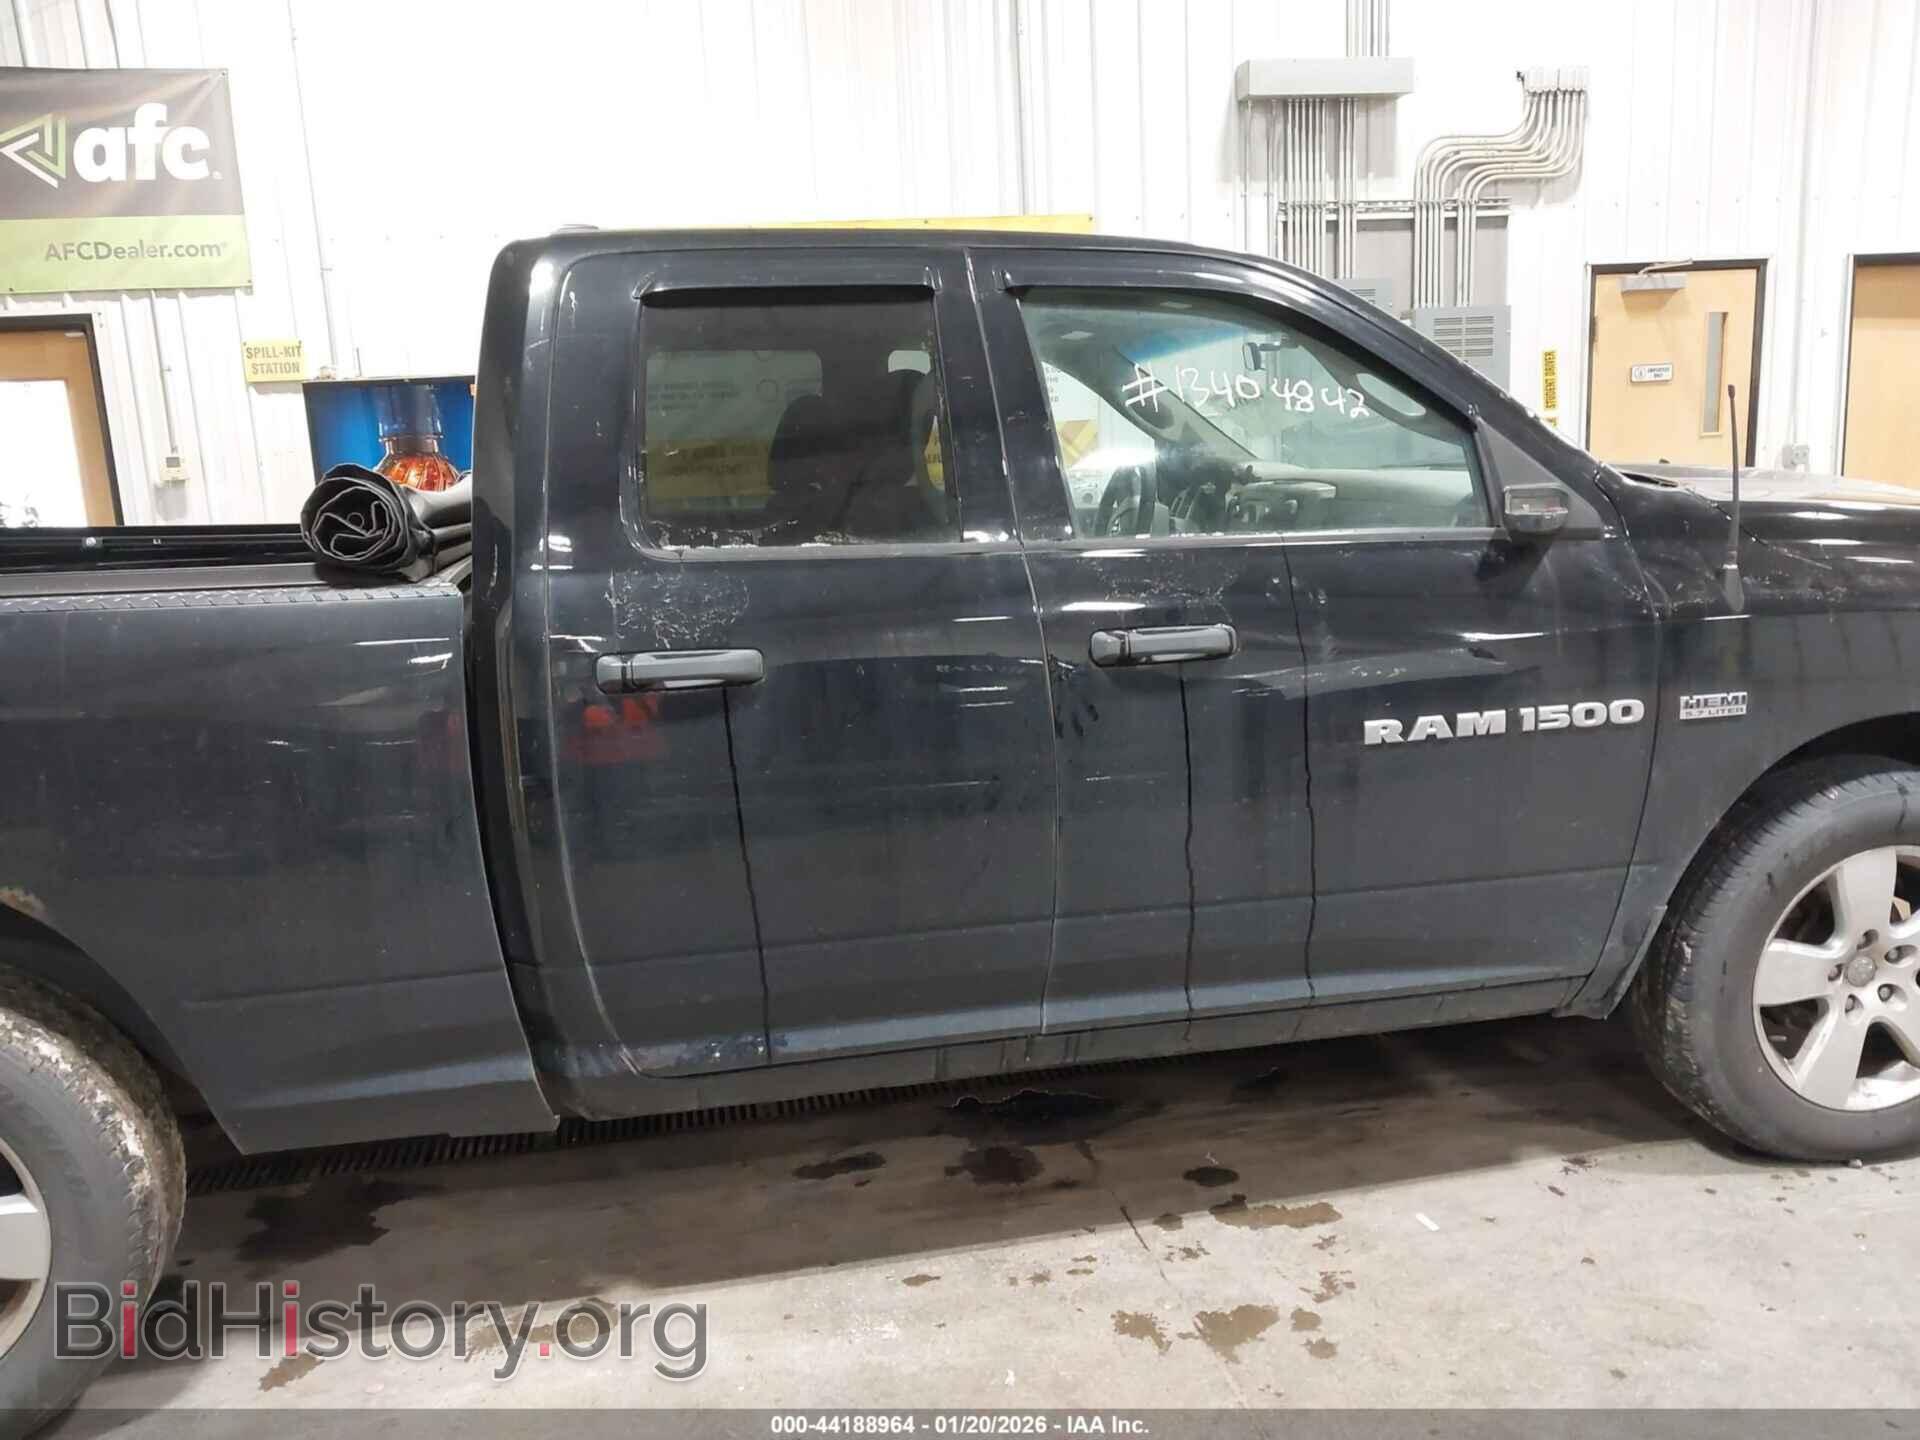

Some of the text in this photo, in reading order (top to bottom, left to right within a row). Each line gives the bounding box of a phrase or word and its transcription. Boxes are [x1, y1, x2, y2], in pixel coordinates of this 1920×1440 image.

[44, 239, 222, 262] AFCDealer.com
[246, 345, 302, 359] SPILL-KIT
[251, 361, 300, 375] STATION
[1544, 351, 1556, 376] DRIVER
[1680, 692, 1747, 710] HEMI
[1707, 706, 1744, 716] LITER
[1363, 699, 1645, 745] RAM 1500
